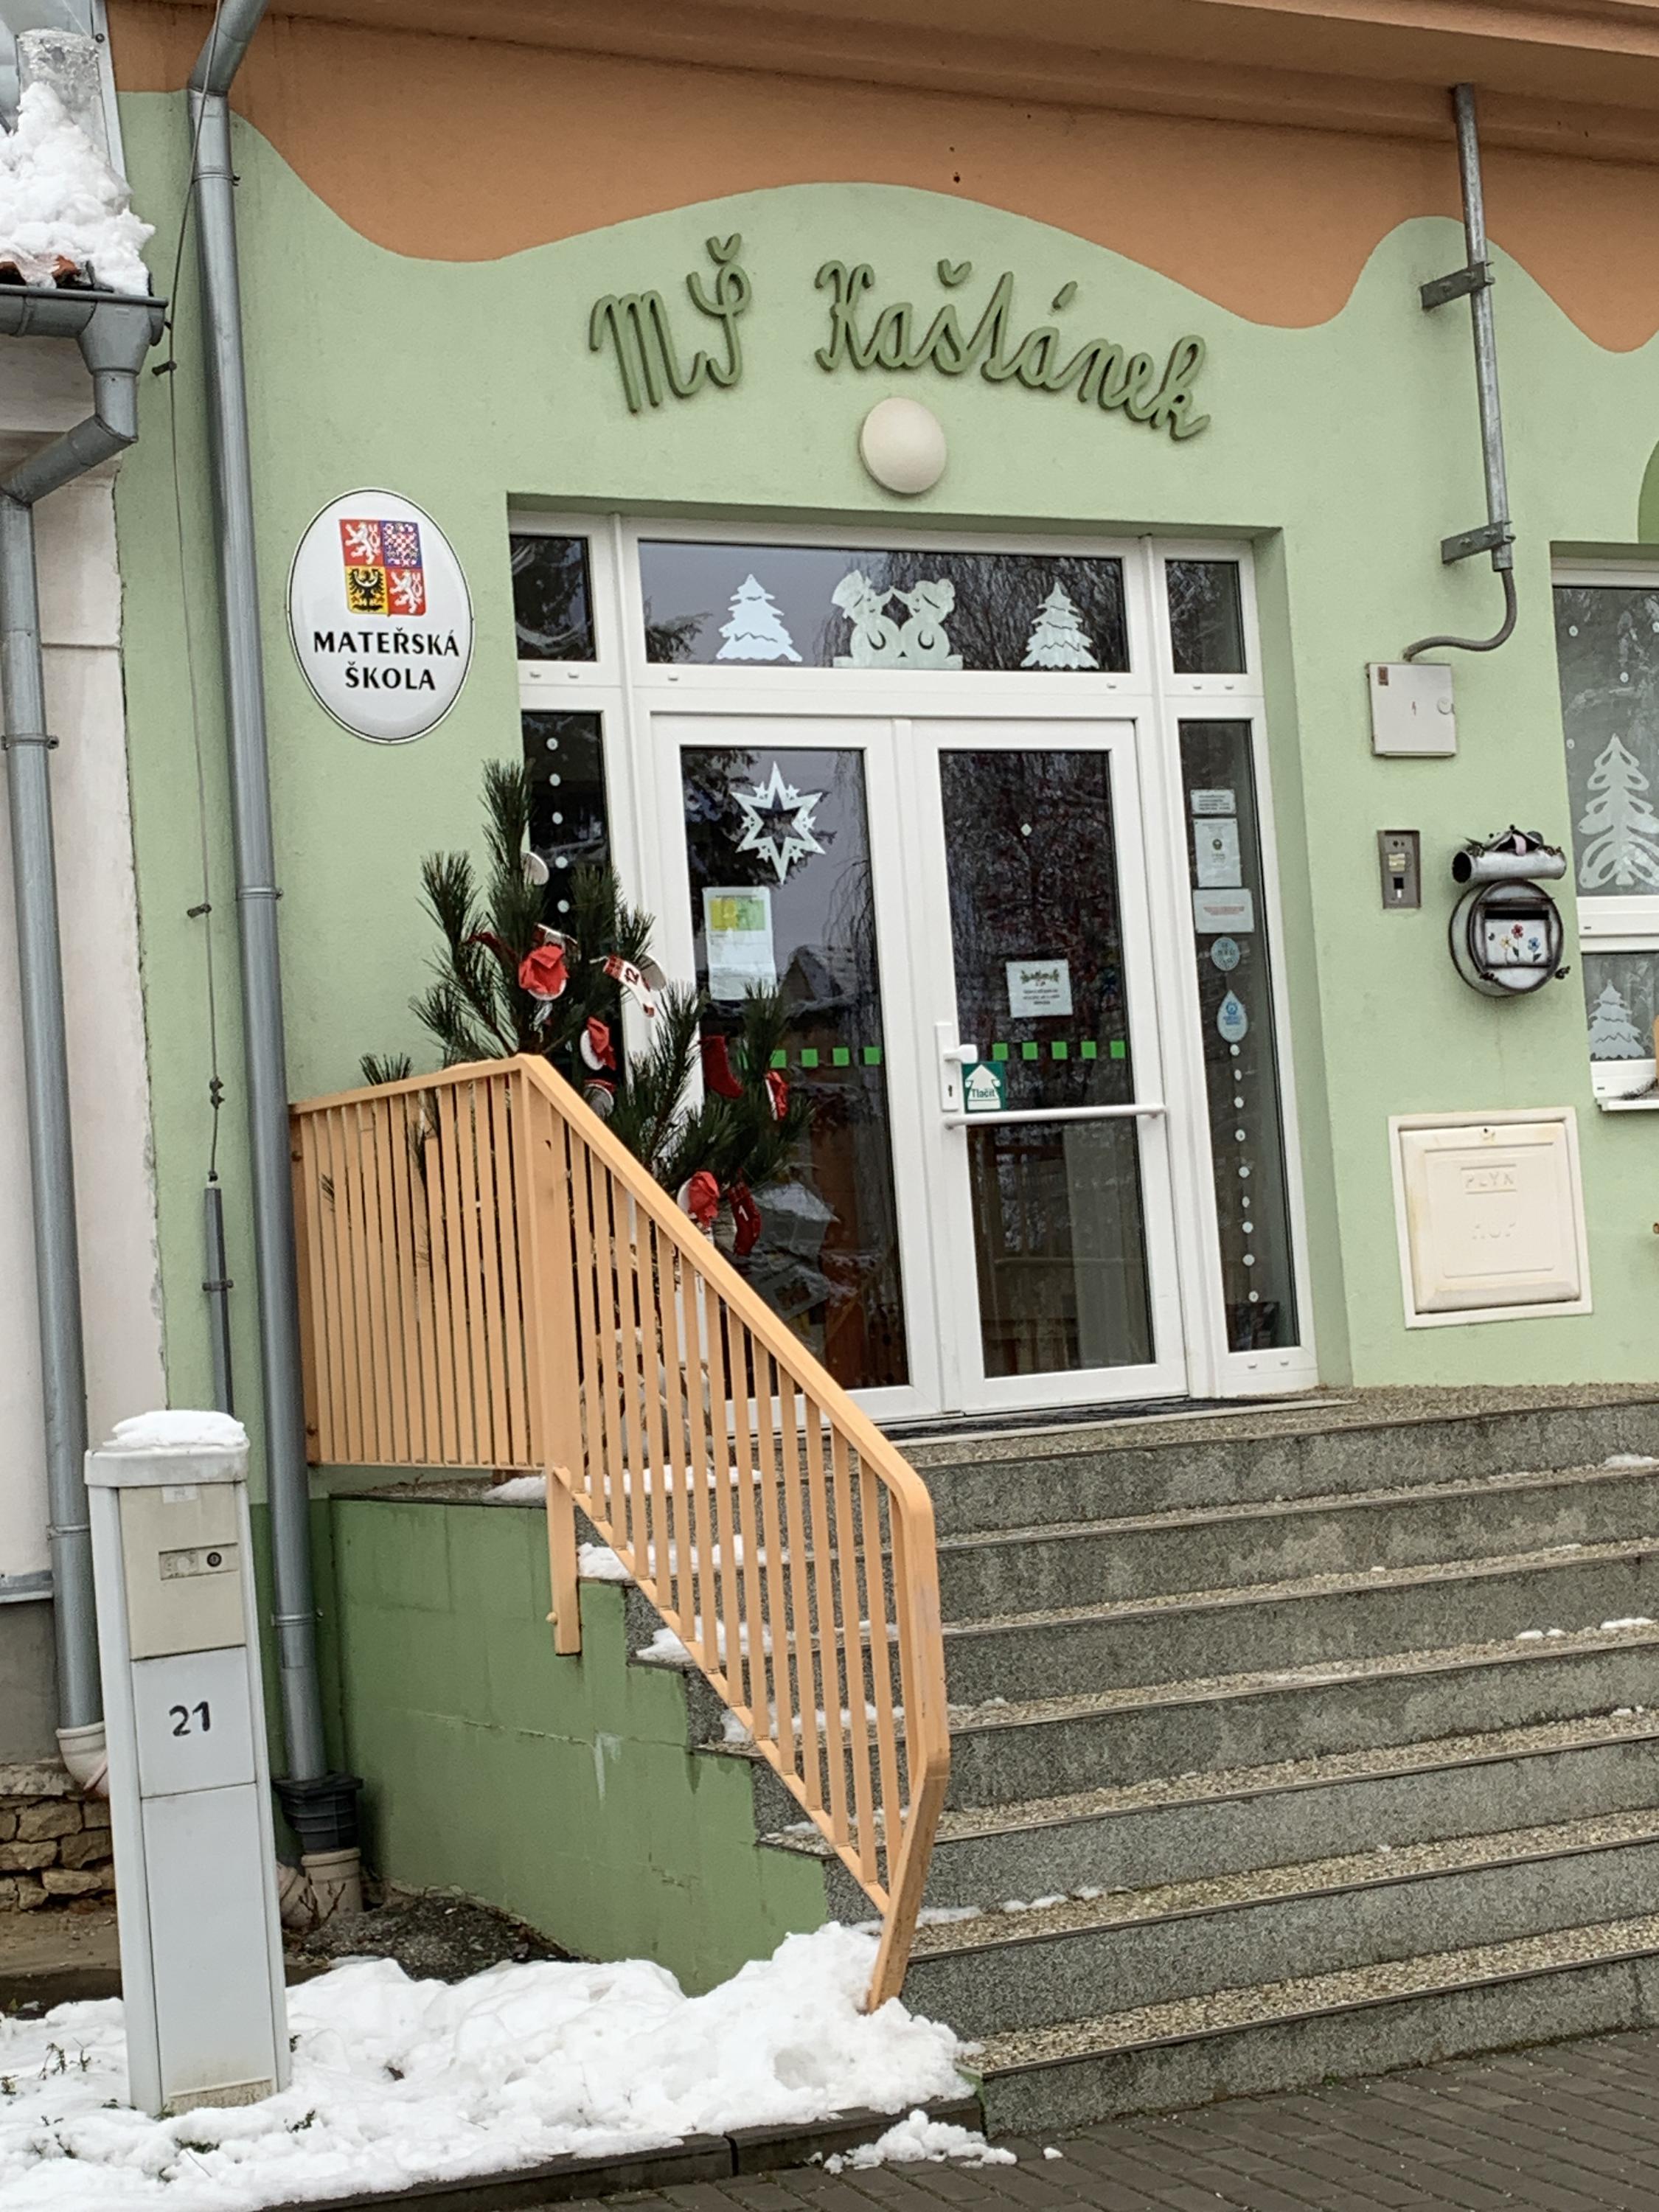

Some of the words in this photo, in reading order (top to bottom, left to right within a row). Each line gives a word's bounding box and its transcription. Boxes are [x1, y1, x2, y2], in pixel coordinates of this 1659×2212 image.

[590, 233, 751, 414] MŠ
[313, 627, 459, 657] MATEŘSKÁ
[345, 661, 436, 691] ŠKOLA
[970, 1088, 995, 1098] Tlačit
[738, 1205, 748, 1221] 1
[169, 1701, 211, 1736] 21
